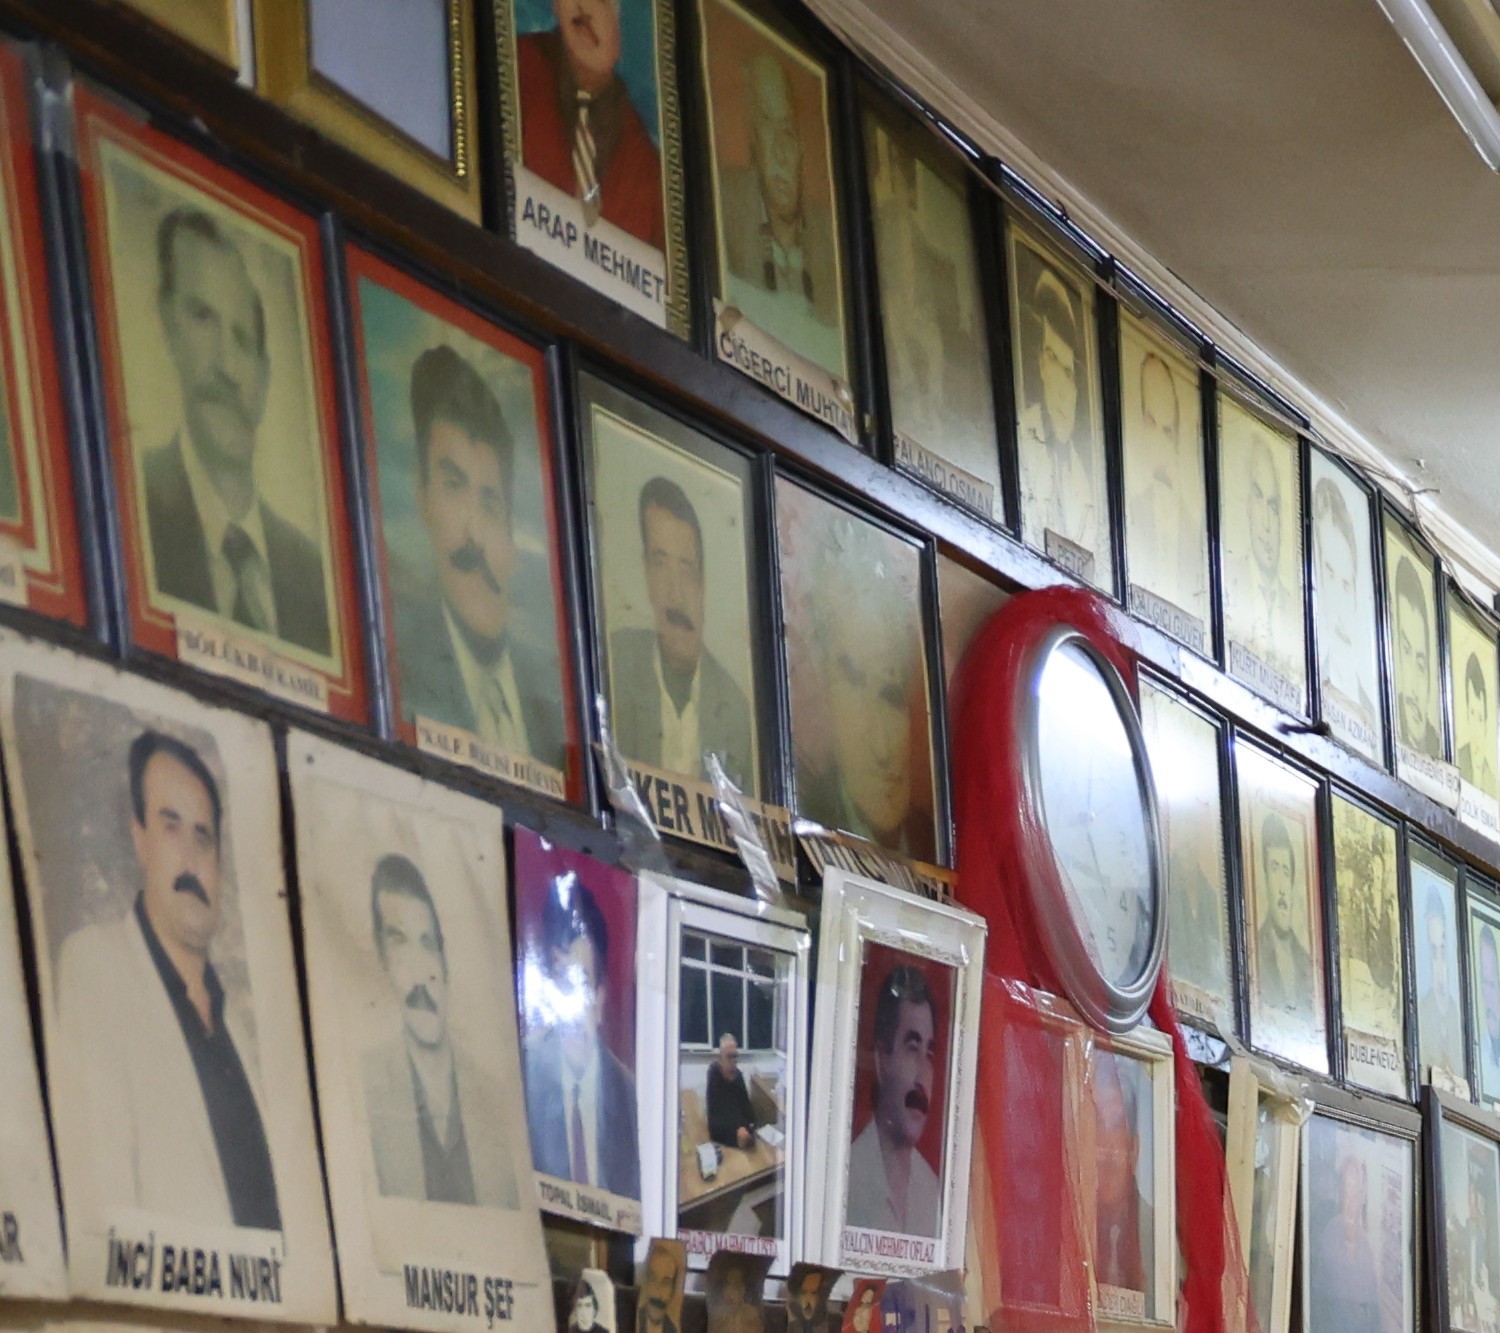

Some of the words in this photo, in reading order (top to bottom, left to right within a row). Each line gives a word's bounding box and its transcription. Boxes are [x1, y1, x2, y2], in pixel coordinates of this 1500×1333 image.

[522, 196, 578, 251] ARAP
[583, 231, 665, 305] MEHMET
[797, 376, 858, 434] MUHTA
[107, 1226, 154, 1292] İNCİ
[161, 1244, 223, 1300] BABA
[228, 1246, 283, 1304] NURİ
[403, 1263, 479, 1317] MANSUR
[484, 1275, 514, 1331] ŞEF
